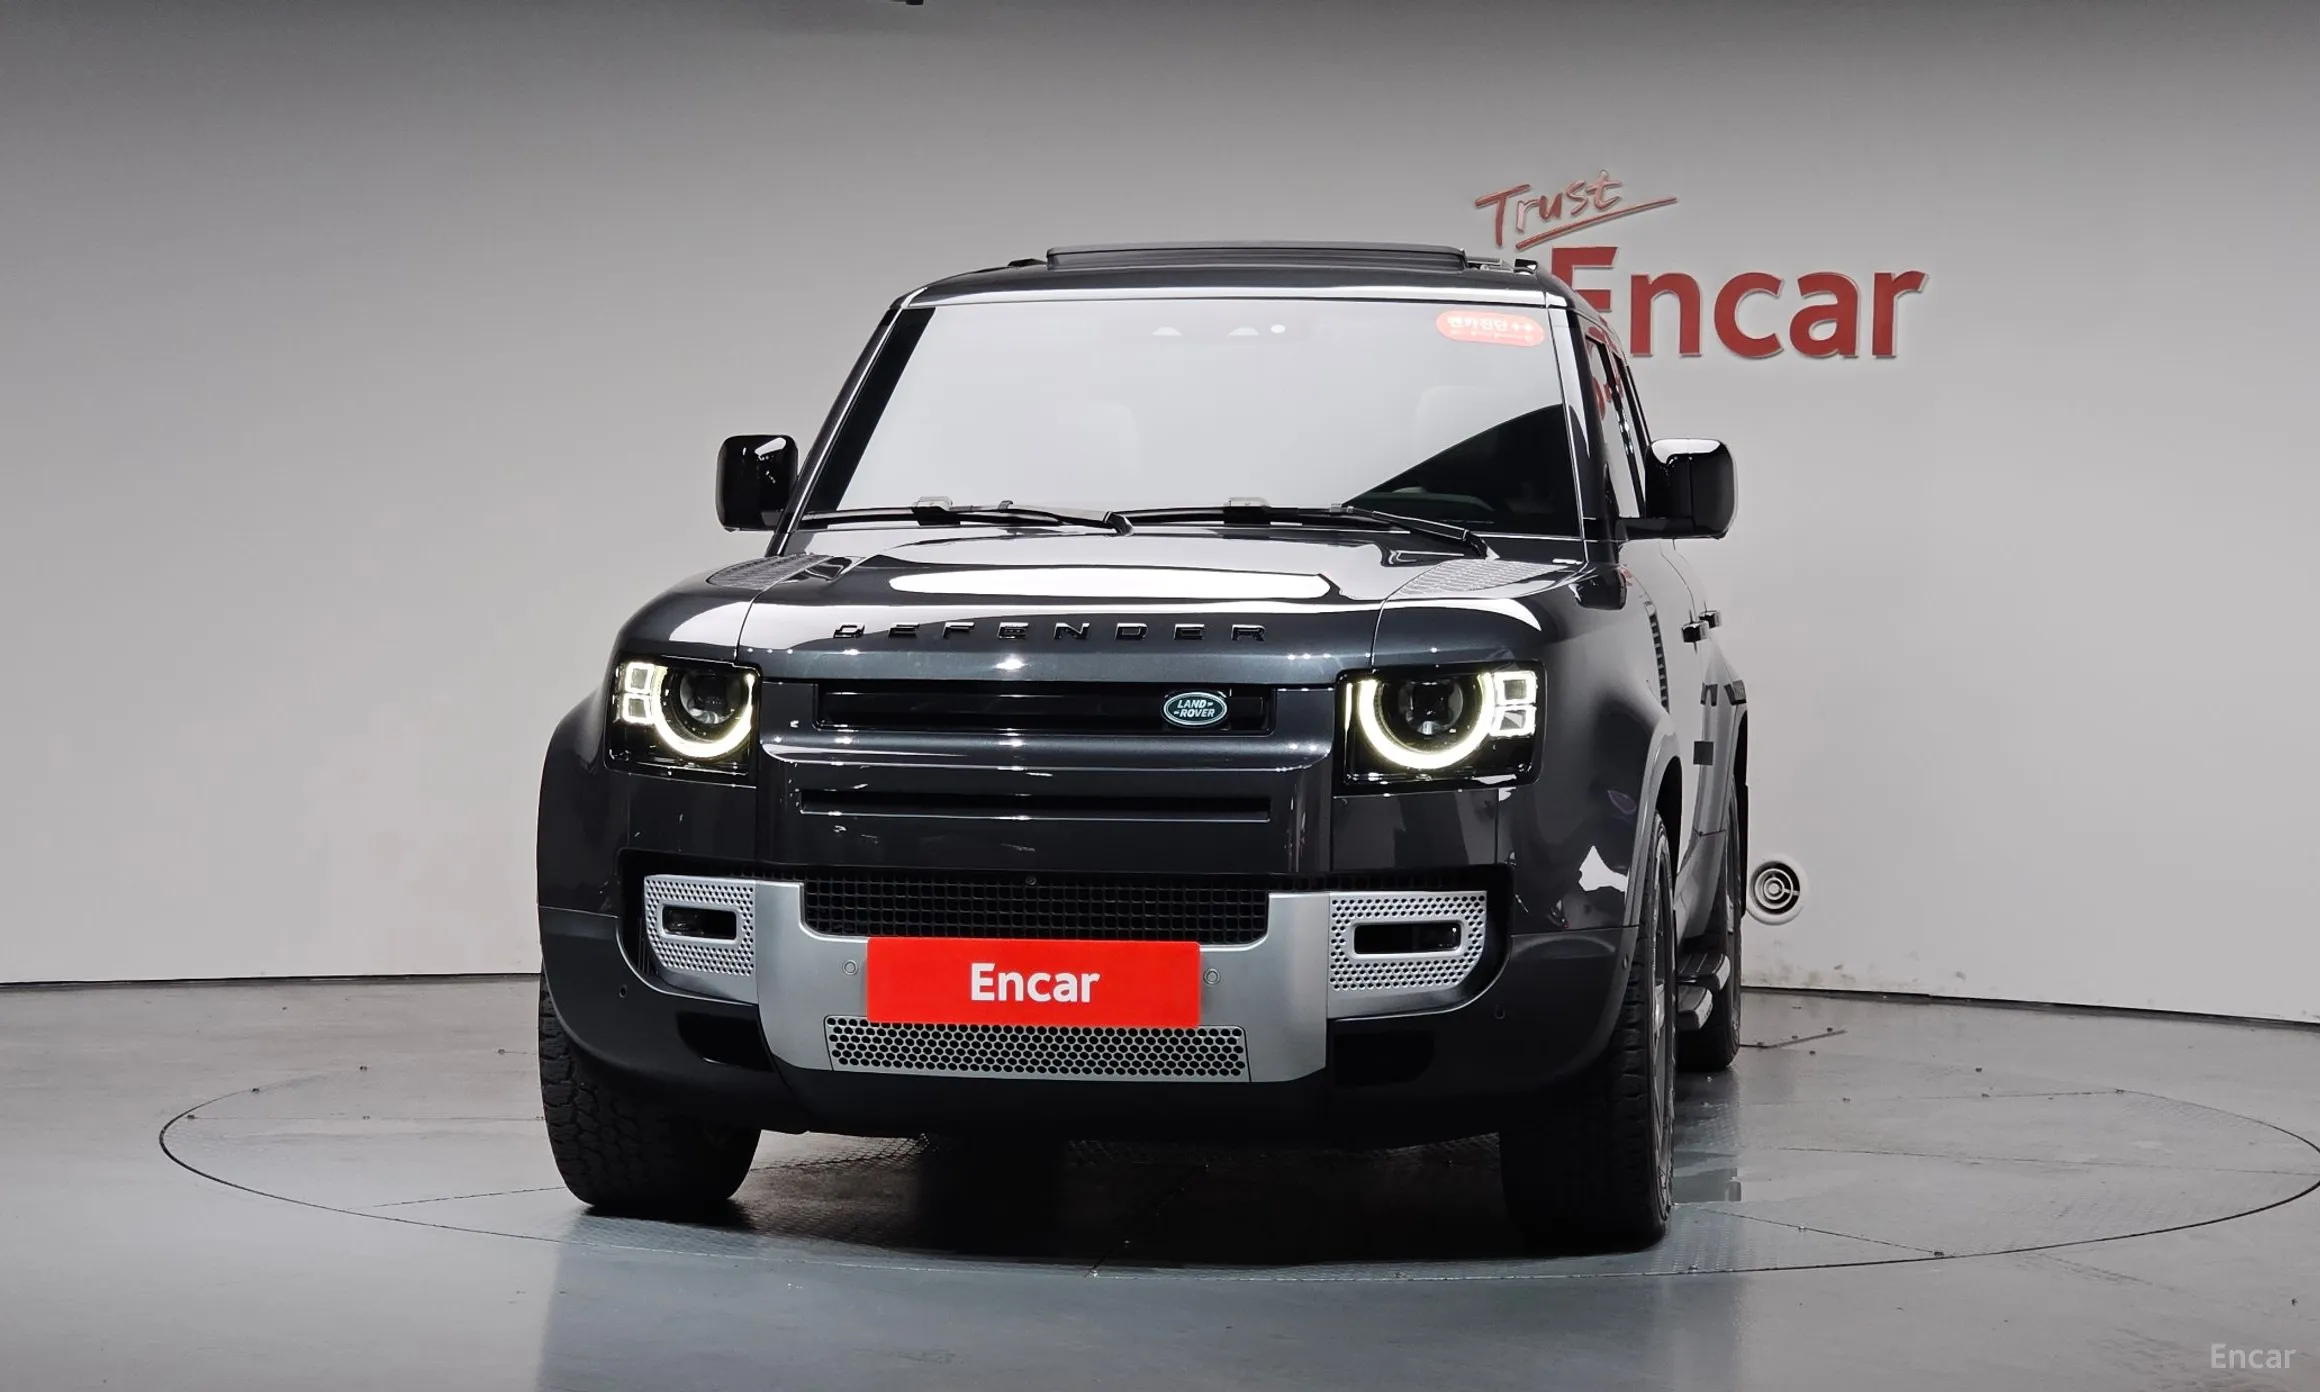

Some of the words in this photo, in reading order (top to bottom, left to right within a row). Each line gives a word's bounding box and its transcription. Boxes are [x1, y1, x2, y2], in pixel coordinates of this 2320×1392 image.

[1474, 168, 1623, 247] Trust
[833, 621, 1267, 641] DEFENDER
[970, 962, 1101, 1004] Encar
